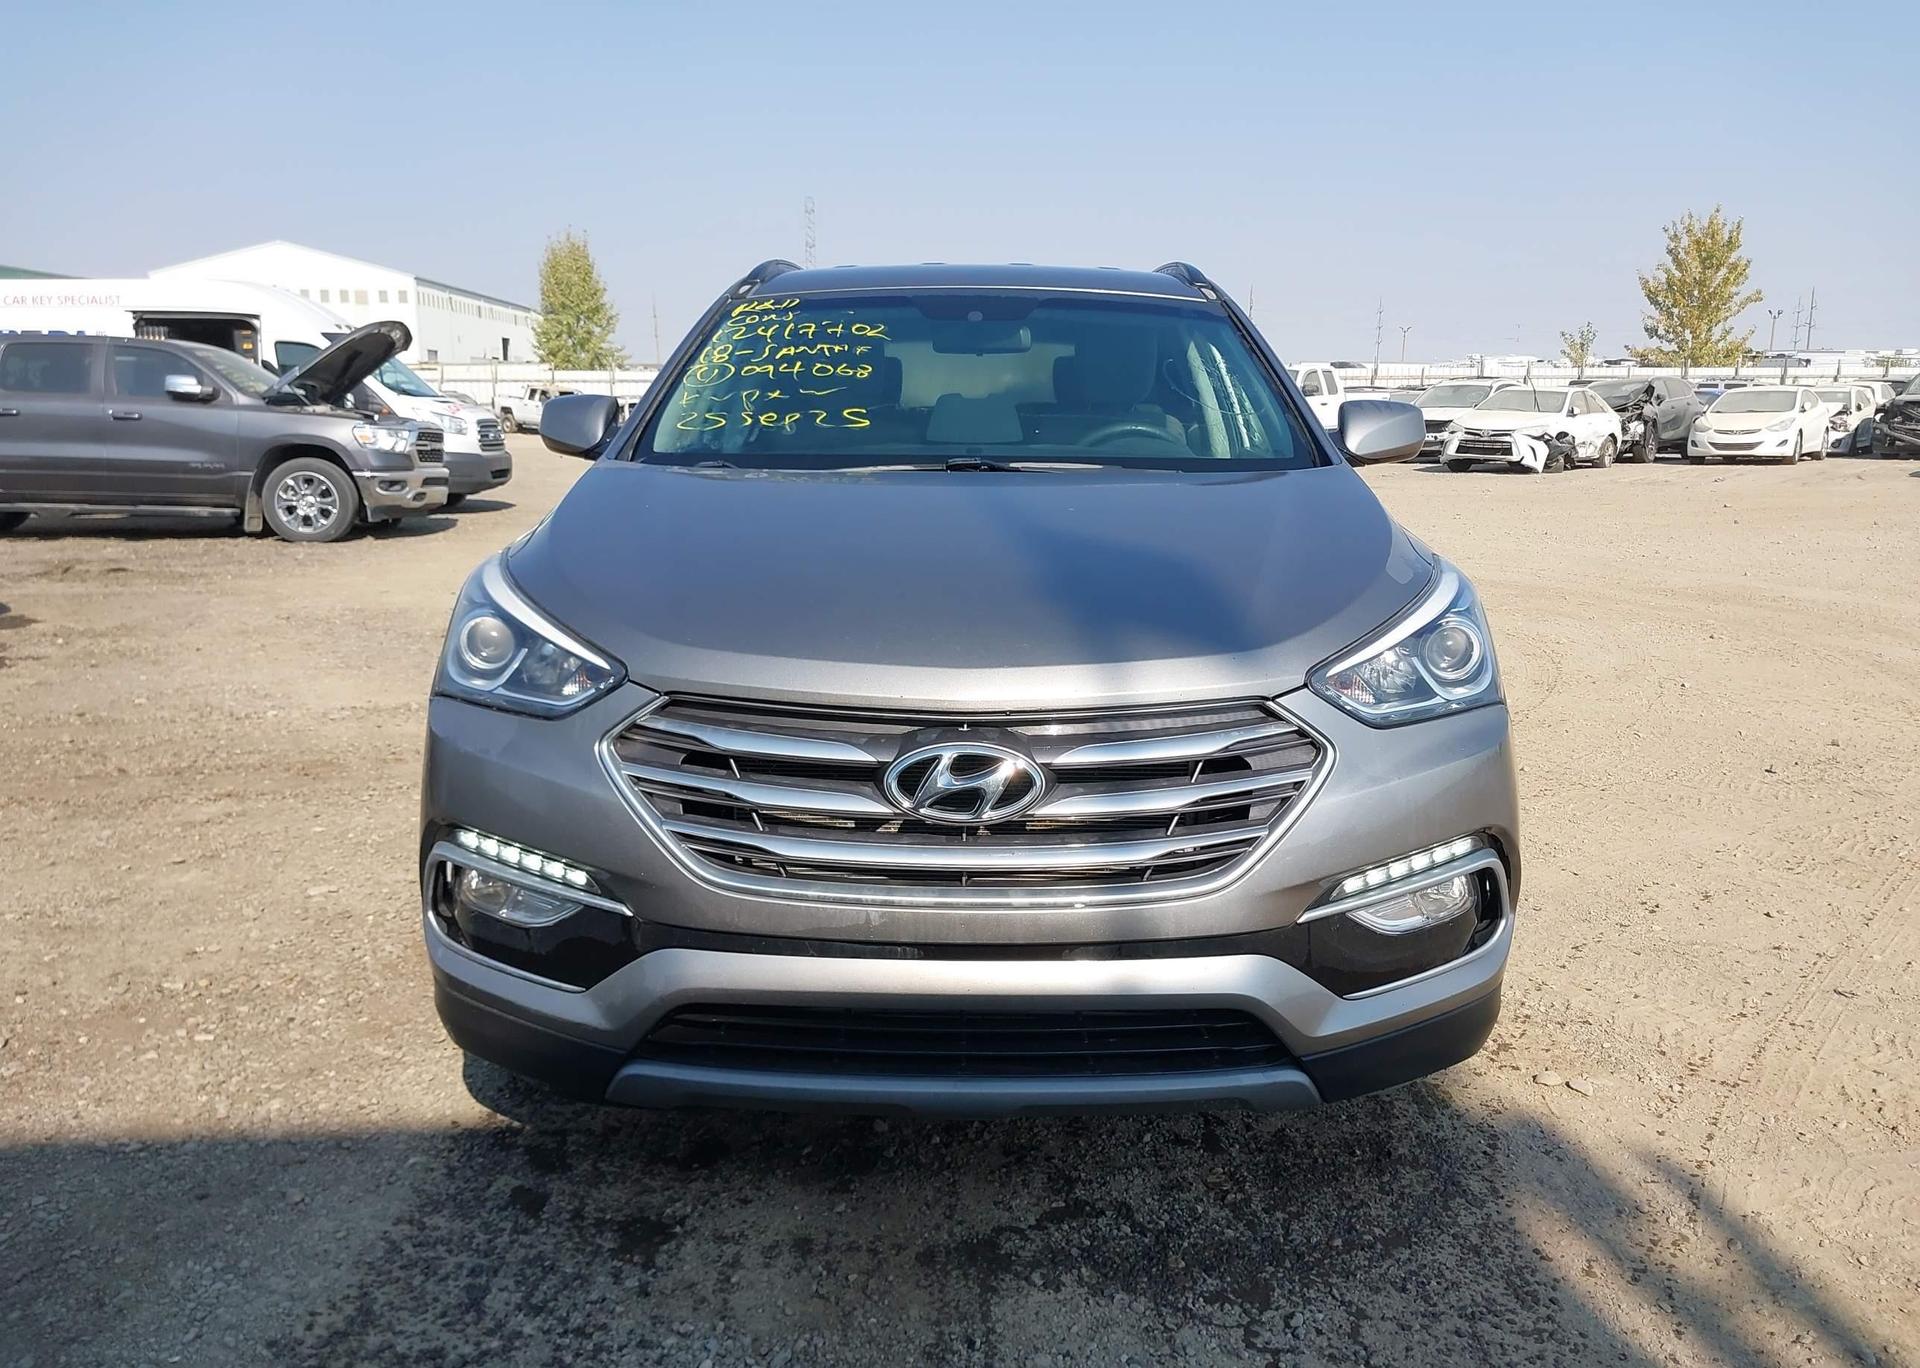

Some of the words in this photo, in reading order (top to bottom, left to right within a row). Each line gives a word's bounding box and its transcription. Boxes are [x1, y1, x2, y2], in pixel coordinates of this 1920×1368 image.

[3, 295, 28, 305] CAR
[31, 295, 53, 305] KEY
[56, 295, 120, 305] SPECIALIST
